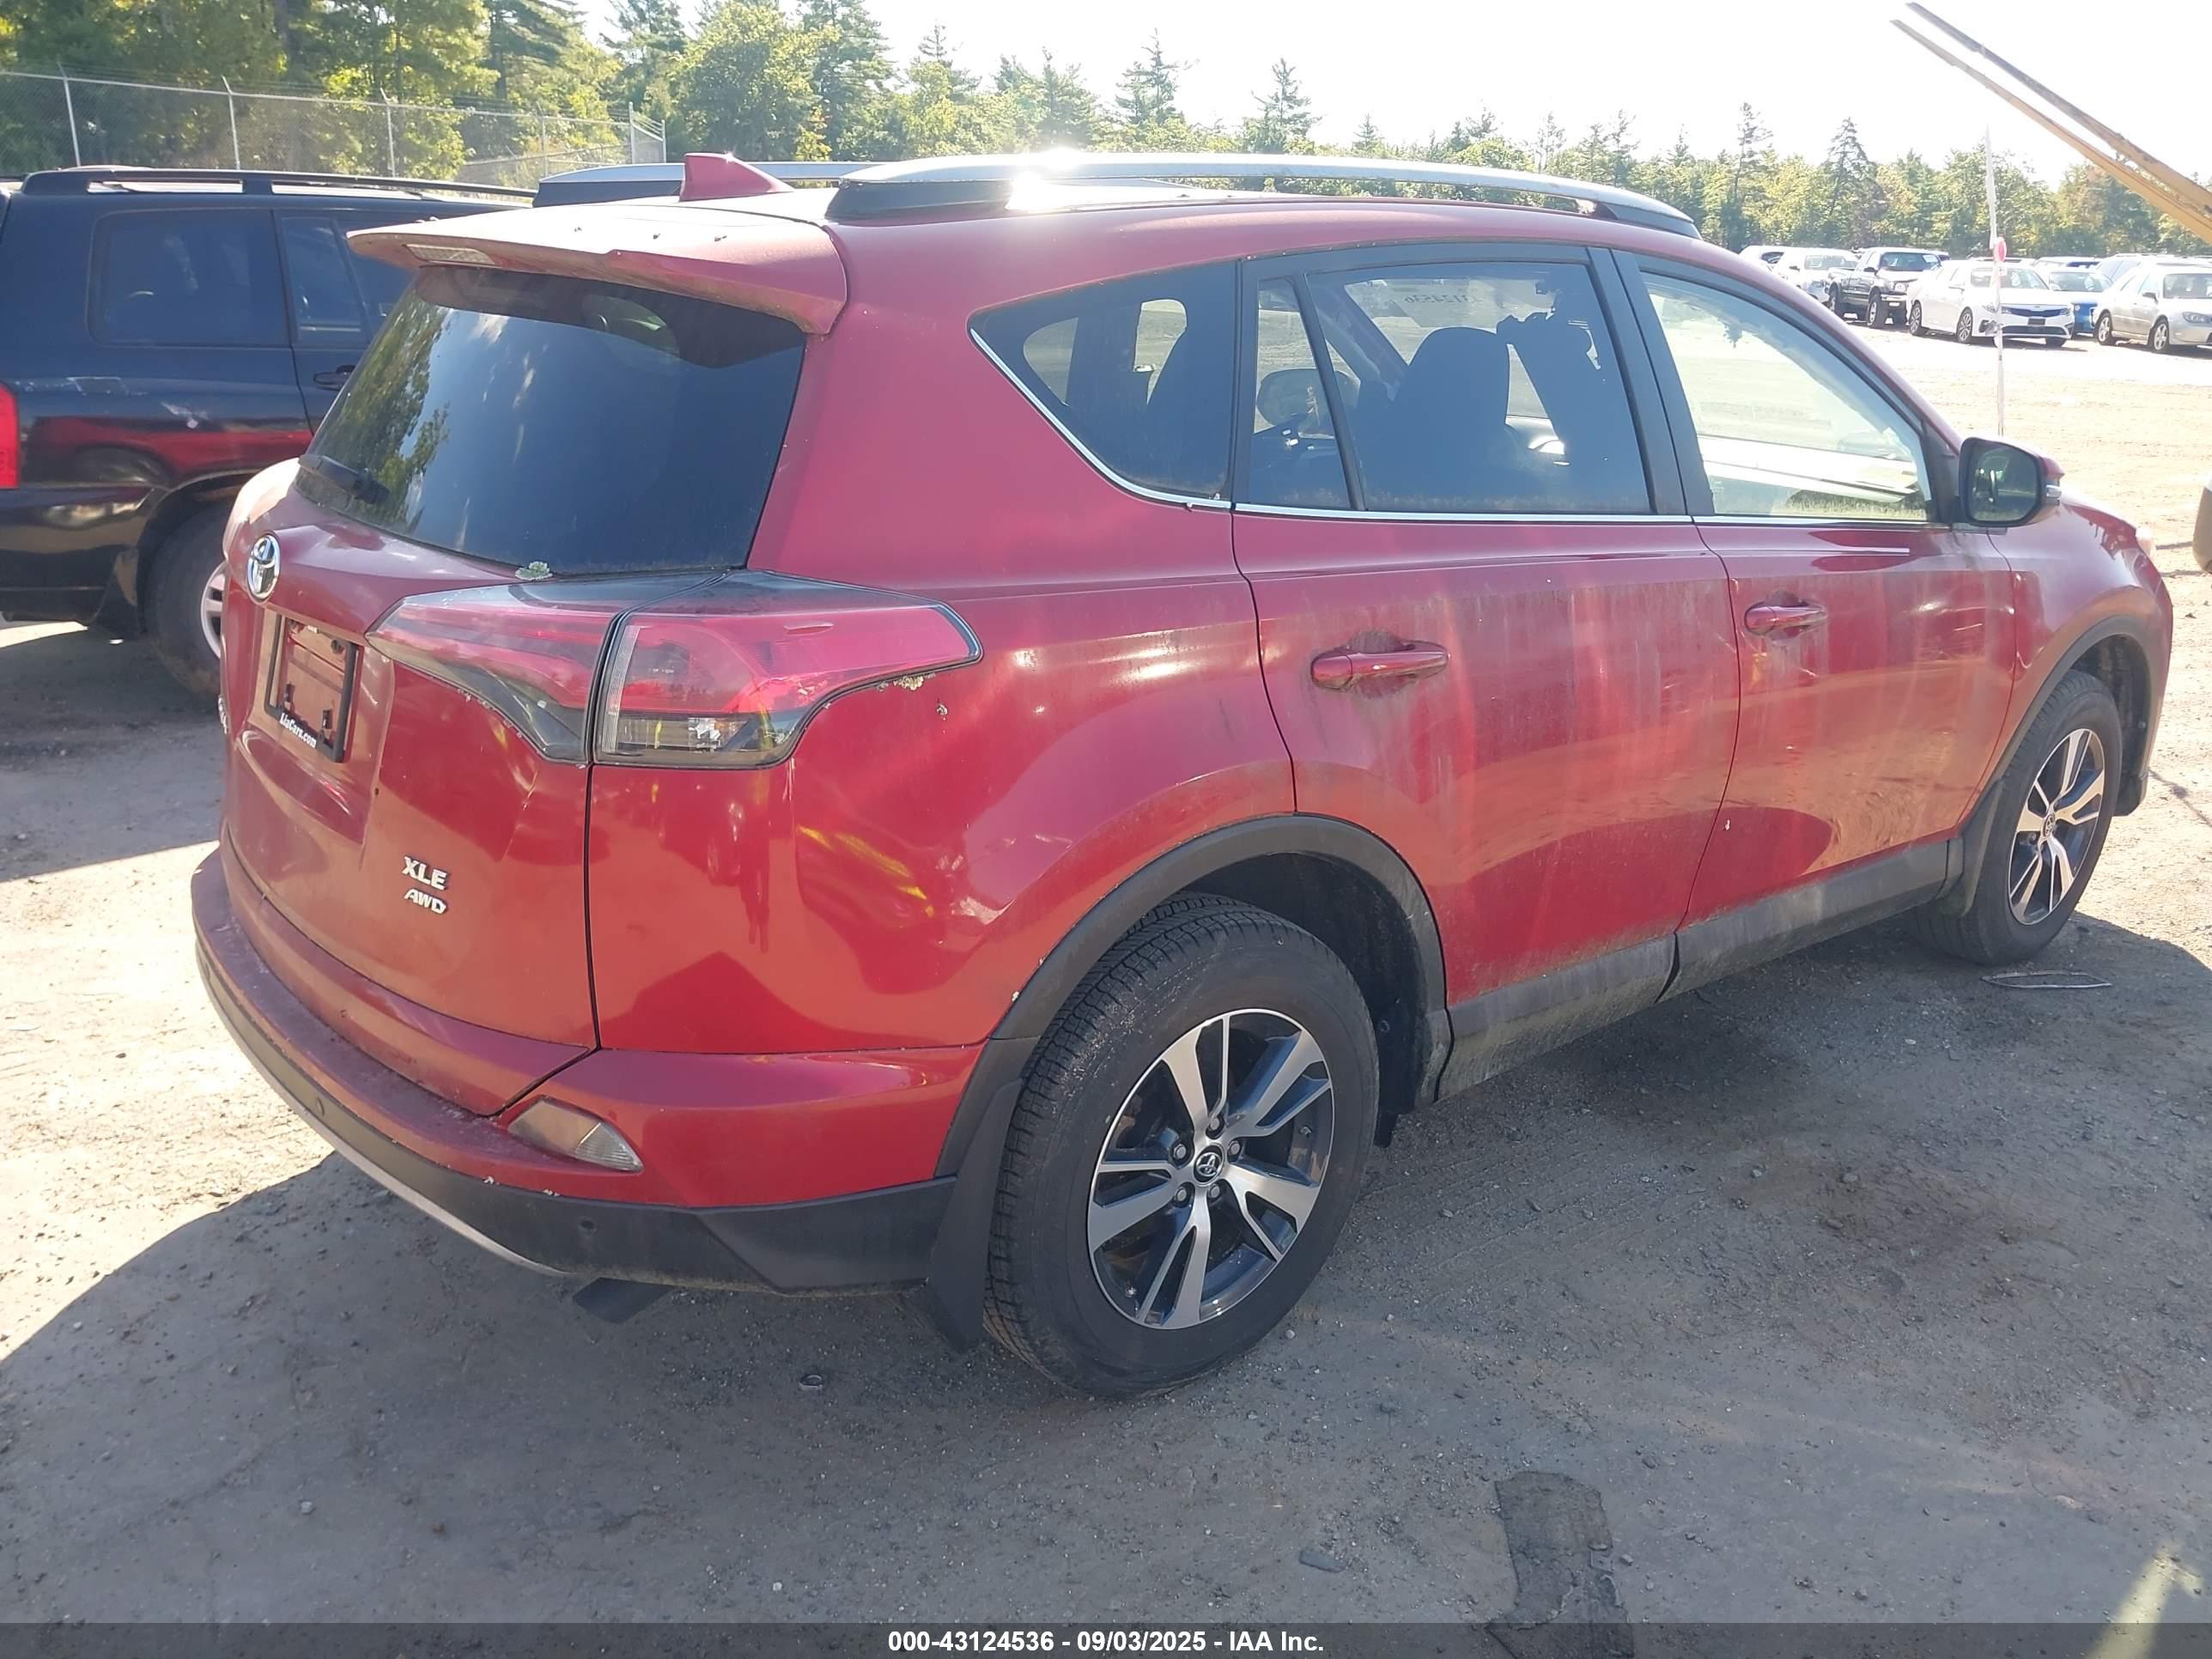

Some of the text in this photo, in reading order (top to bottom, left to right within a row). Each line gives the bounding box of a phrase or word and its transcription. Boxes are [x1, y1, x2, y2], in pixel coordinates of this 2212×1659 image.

[279, 712, 317, 749] LiaCars.com
[402, 855, 447, 890] XLE
[404, 888, 447, 915] AWD
